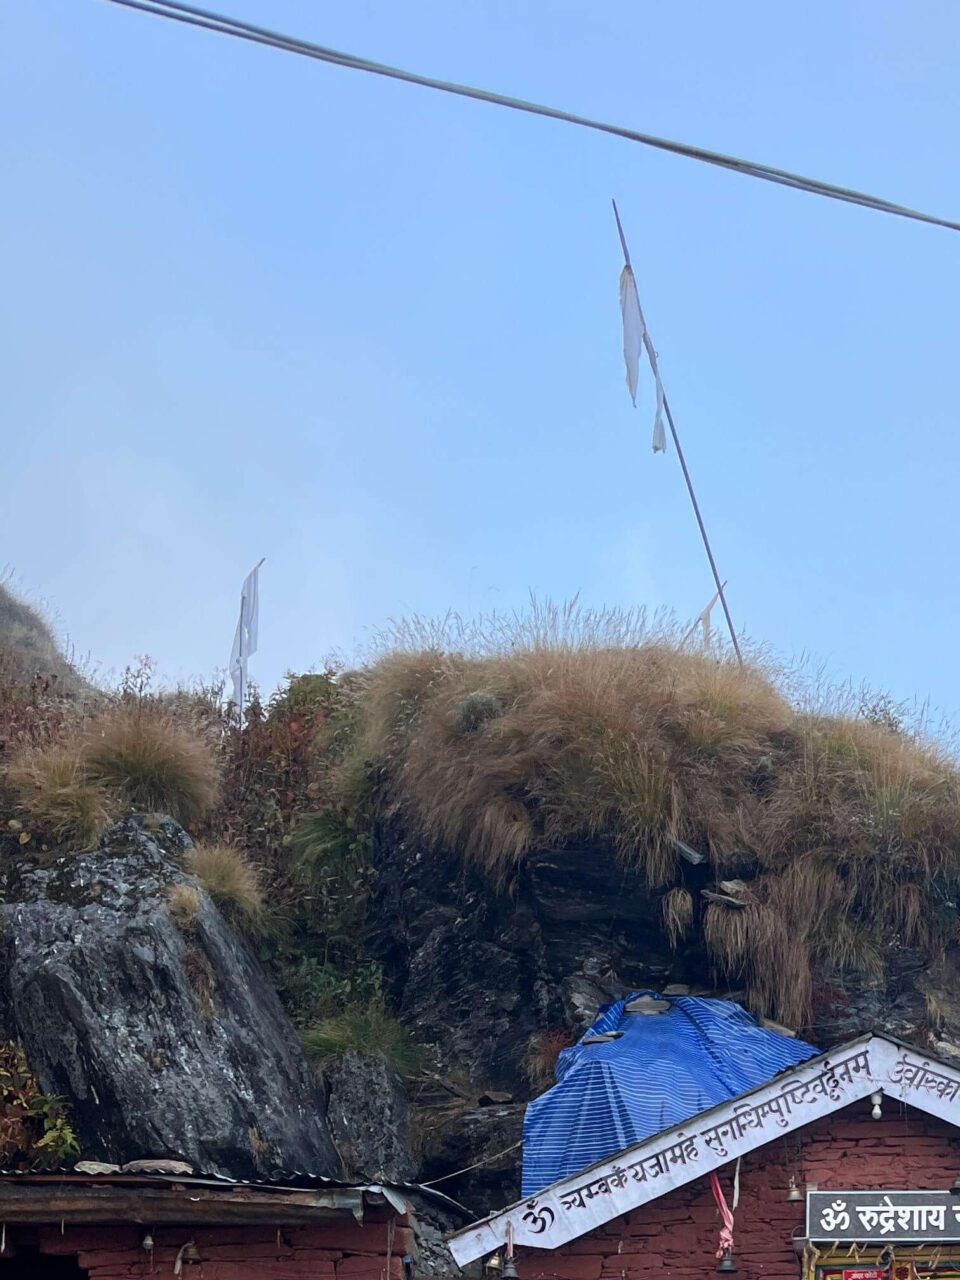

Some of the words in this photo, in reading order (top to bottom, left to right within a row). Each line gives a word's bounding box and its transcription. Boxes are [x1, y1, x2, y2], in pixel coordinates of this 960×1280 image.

[522, 1199, 555, 1234] ॐ
[627, 1132, 699, 1182] यजामहे
[820, 1199, 850, 1232] ॐ
[855, 1195, 947, 1235] रुद्रेशाय
